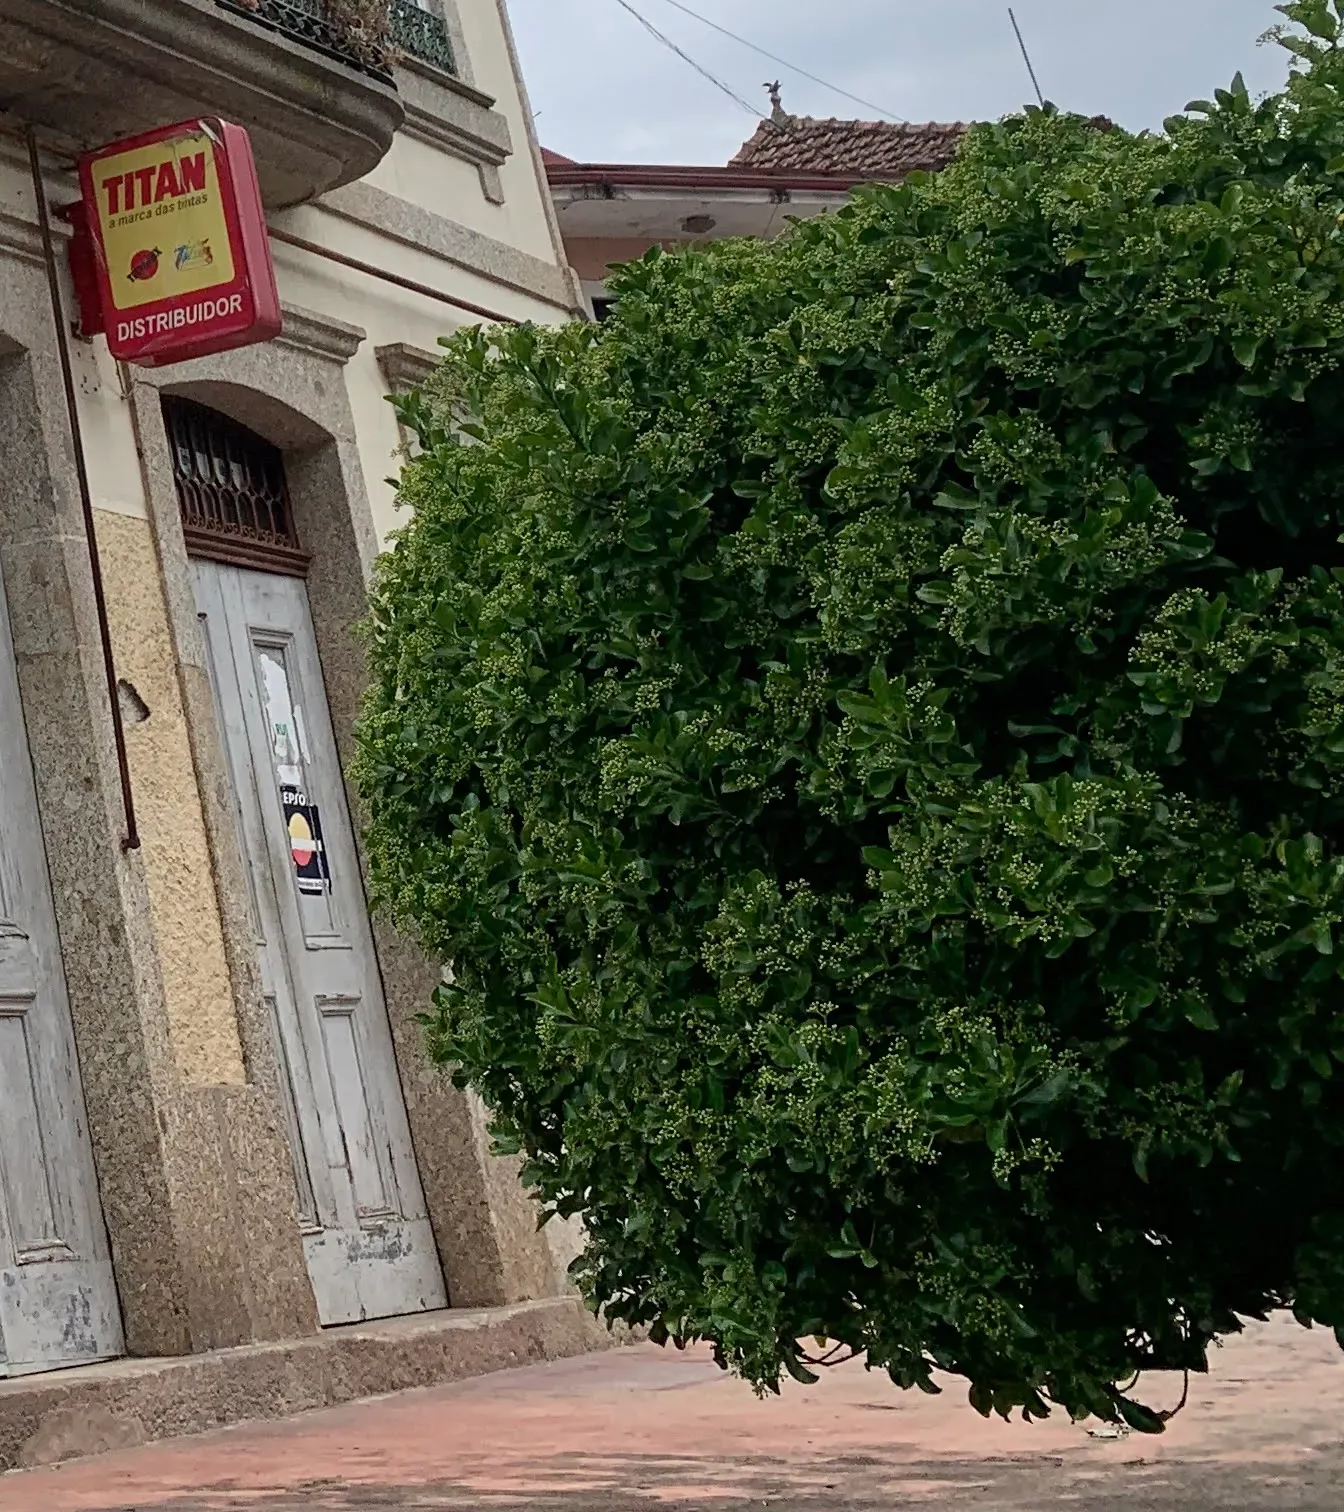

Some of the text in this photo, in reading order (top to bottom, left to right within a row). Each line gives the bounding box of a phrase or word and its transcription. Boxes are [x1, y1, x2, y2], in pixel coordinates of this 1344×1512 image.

[102, 152, 207, 216] TITAN
[108, 193, 208, 229] a marca das tintas
[117, 294, 242, 342] DISTRIBUIDOR
